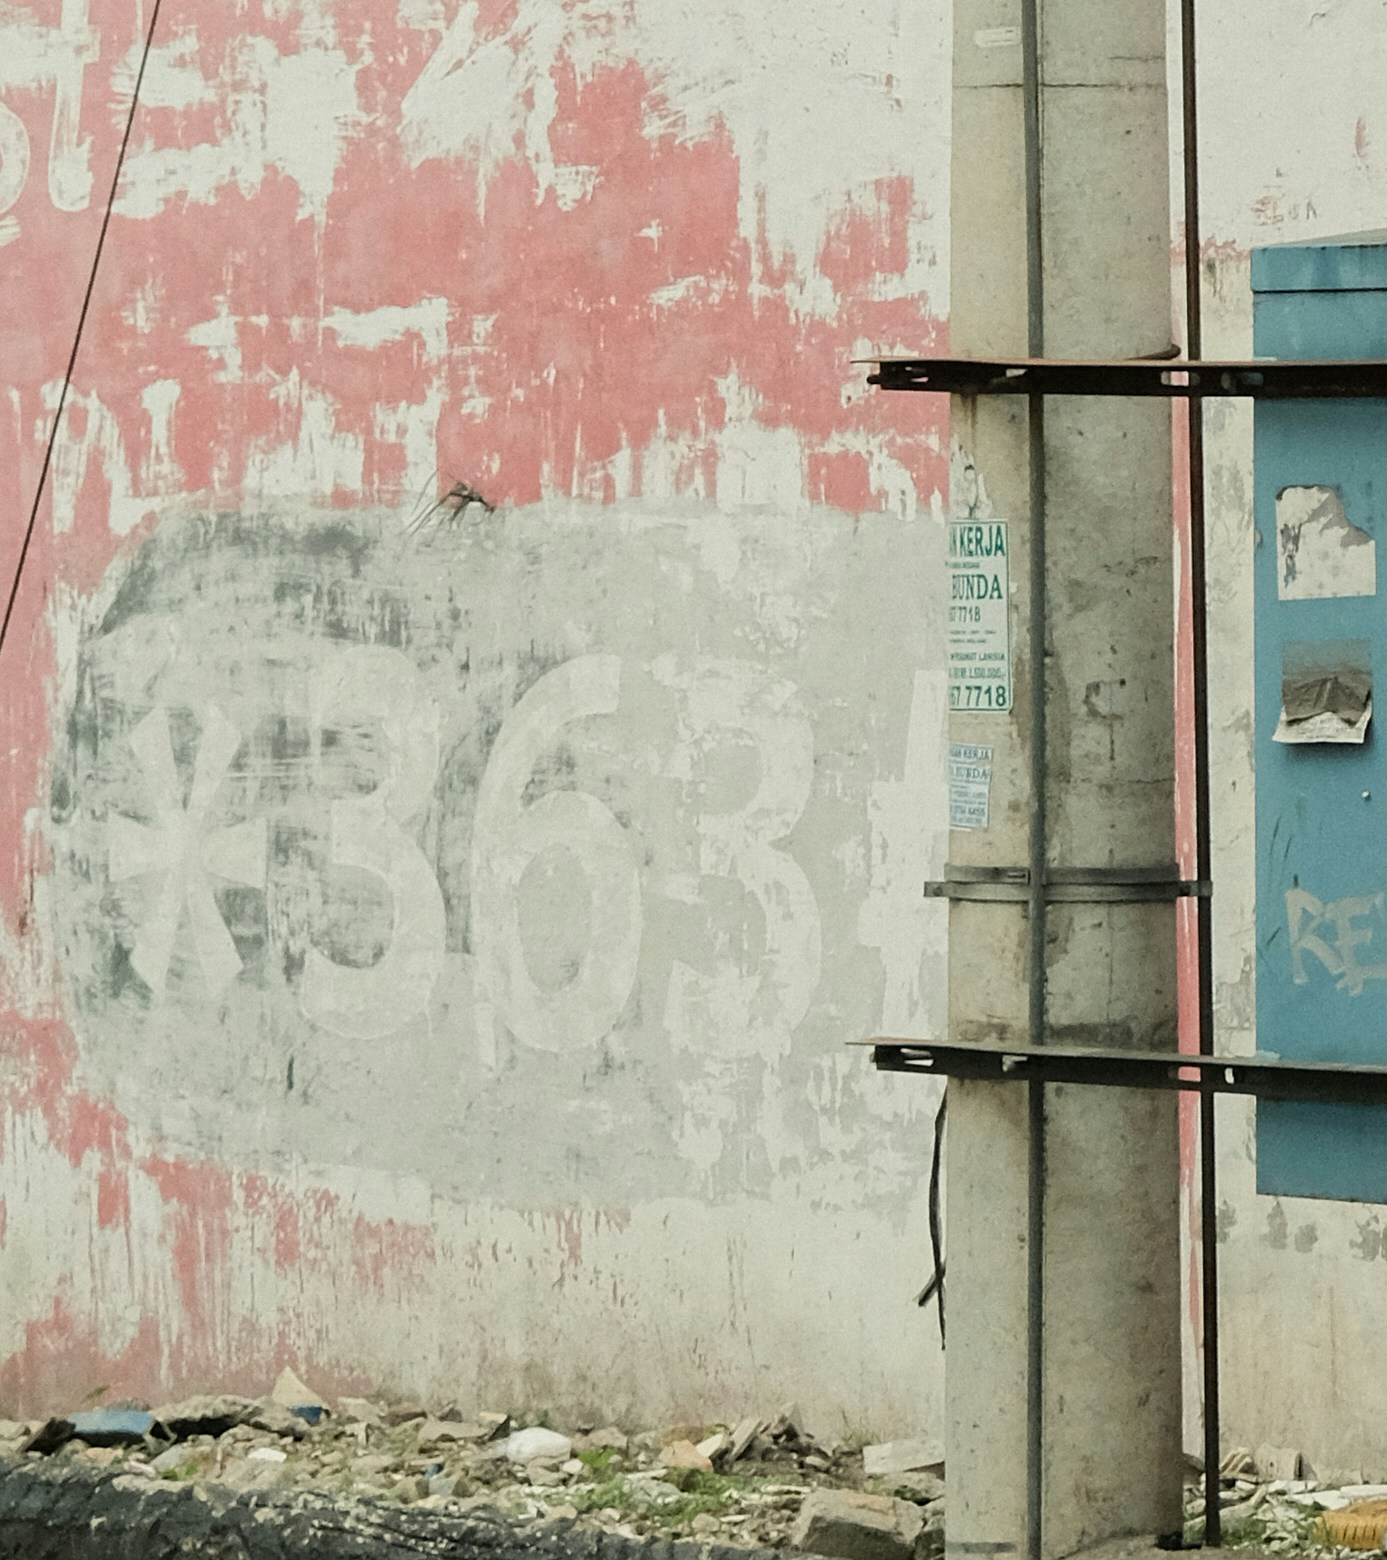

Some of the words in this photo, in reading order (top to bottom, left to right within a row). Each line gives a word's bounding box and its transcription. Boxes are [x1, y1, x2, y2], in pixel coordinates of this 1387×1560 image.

[960, 525, 1006, 557] KERJA
[952, 573, 1003, 599] BUNDA
[965, 684, 1006, 707] 7718
